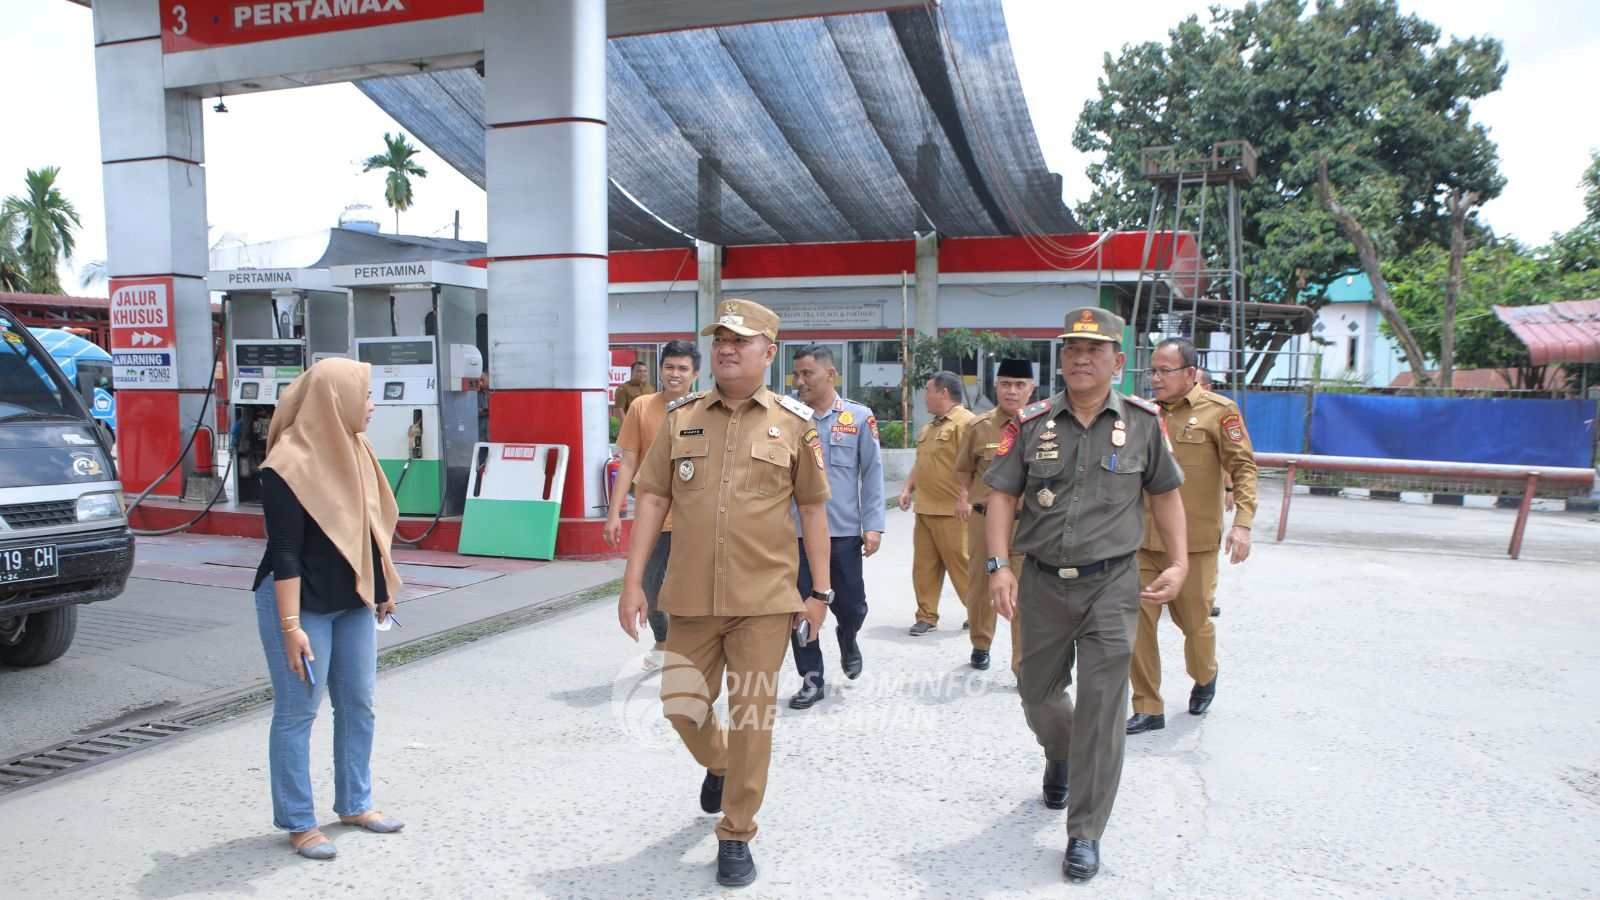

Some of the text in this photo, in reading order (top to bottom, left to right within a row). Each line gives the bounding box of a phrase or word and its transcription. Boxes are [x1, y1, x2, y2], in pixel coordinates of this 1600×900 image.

[172, 5, 188, 35] 3
[229, 271, 292, 284] PERTAMINA
[354, 264, 426, 279] PERTAMINA
[116, 290, 157, 306] JALUR
[113, 308, 164, 325] KHUSUS
[119, 354, 162, 365] WARNING
[0, 547, 53, 571] 19 CH
